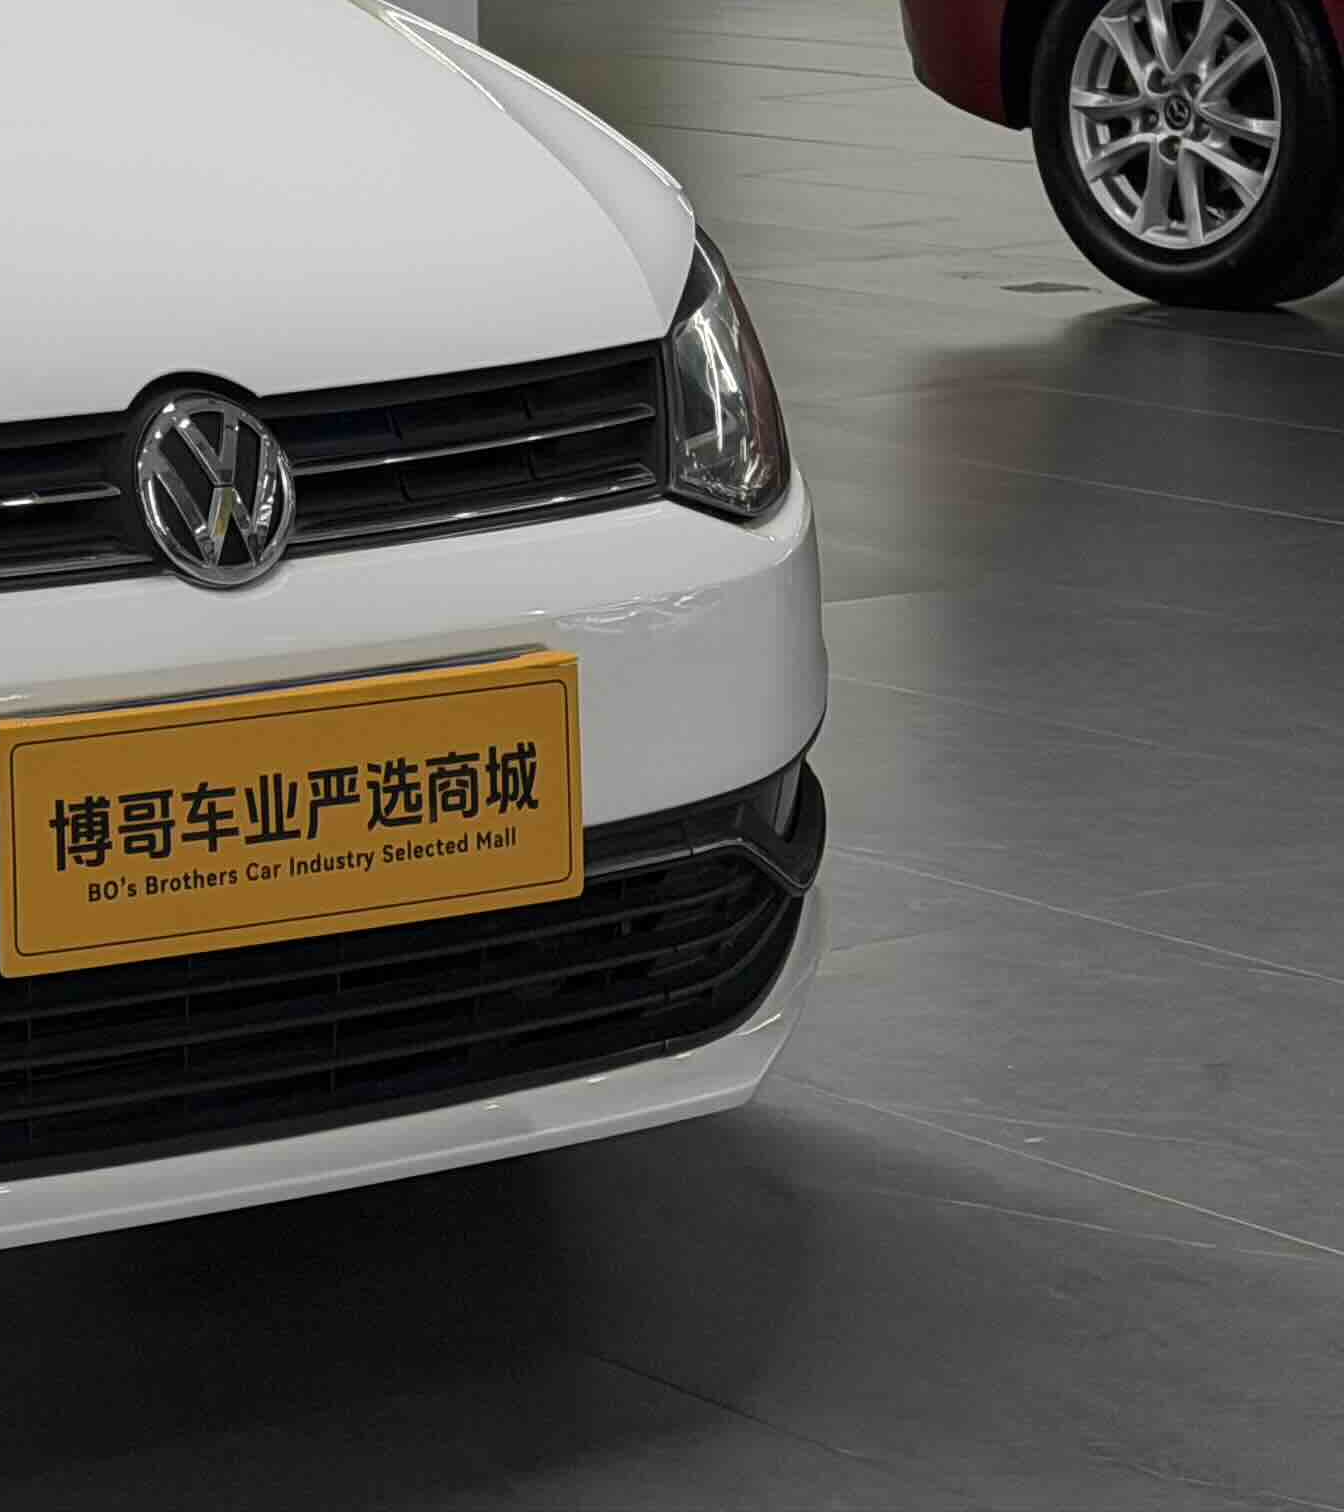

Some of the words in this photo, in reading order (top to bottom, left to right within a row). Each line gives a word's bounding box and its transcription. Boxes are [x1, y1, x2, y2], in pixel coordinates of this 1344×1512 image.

[49, 742, 539, 872] 博哥车业严选商城
[145, 866, 238, 896] Brothers
[245, 861, 282, 882] Car
[289, 851, 375, 877] Industry
[382, 837, 470, 864] Selected
[476, 826, 518, 850] Mall
